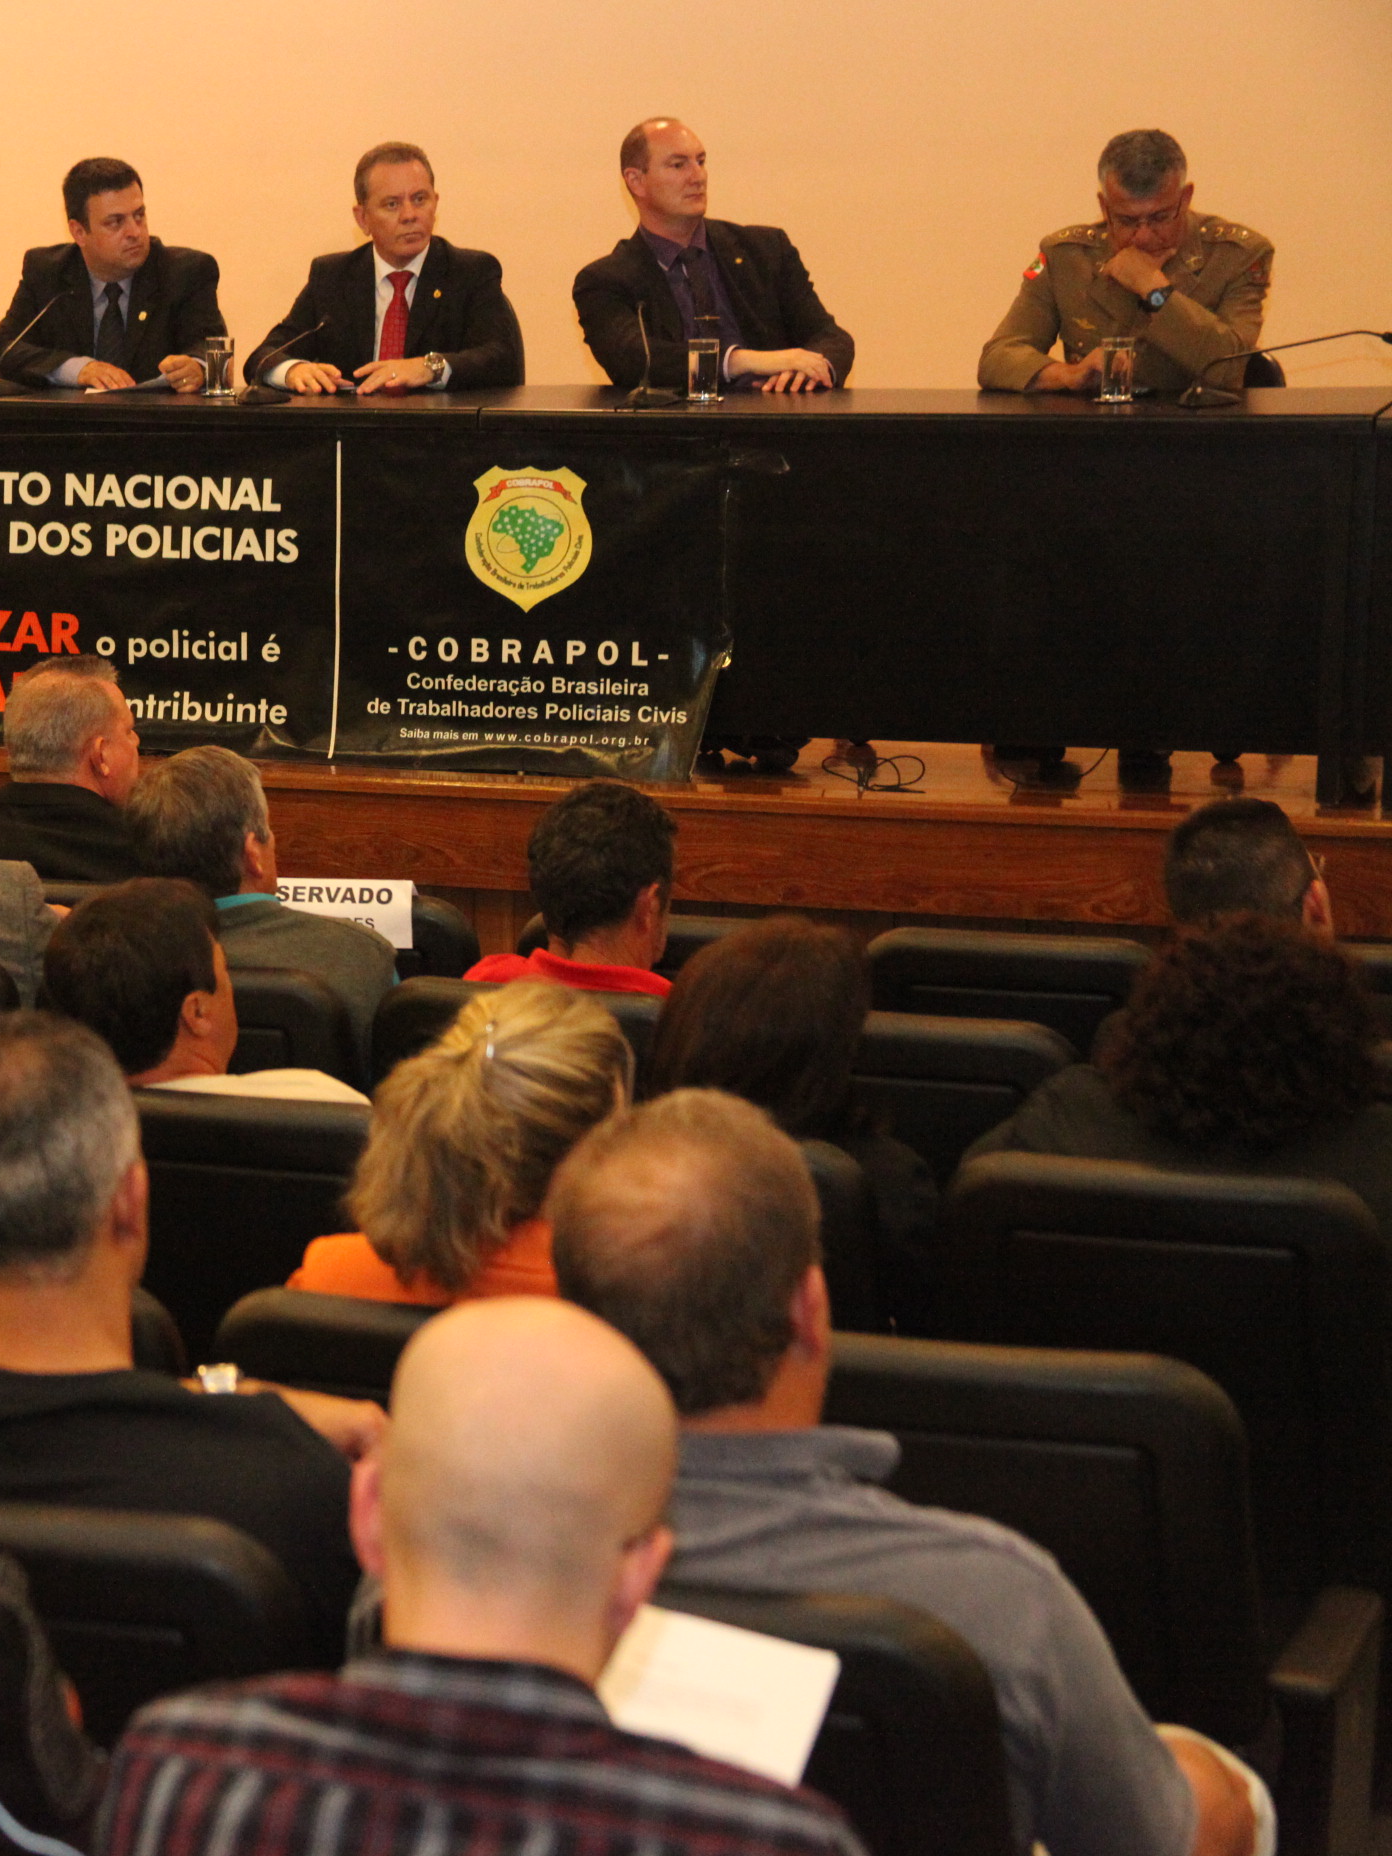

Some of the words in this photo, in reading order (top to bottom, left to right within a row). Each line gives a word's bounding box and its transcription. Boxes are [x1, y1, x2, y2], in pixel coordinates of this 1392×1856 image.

[64, 472, 282, 512] NACIONAL
[505, 478, 555, 491] COBRAPOL
[9, 521, 93, 557] DOS
[106, 523, 300, 563] POLICIAIS
[95, 636, 116, 656] o
[128, 629, 248, 664] policial
[261, 633, 281, 662] é
[406, 672, 545, 697] Confederação
[551, 676, 649, 696] Brasileira
[125, 690, 288, 725] ntribuinte
[366, 697, 391, 714] de
[396, 698, 538, 719] Trabalhadores
[545, 702, 631, 722] Policiais
[637, 705, 688, 724] Civis
[399, 727, 430, 739] Saiba
[433, 729, 459, 740] mais
[462, 731, 479, 741] em
[277, 885, 393, 905] SERVADO
